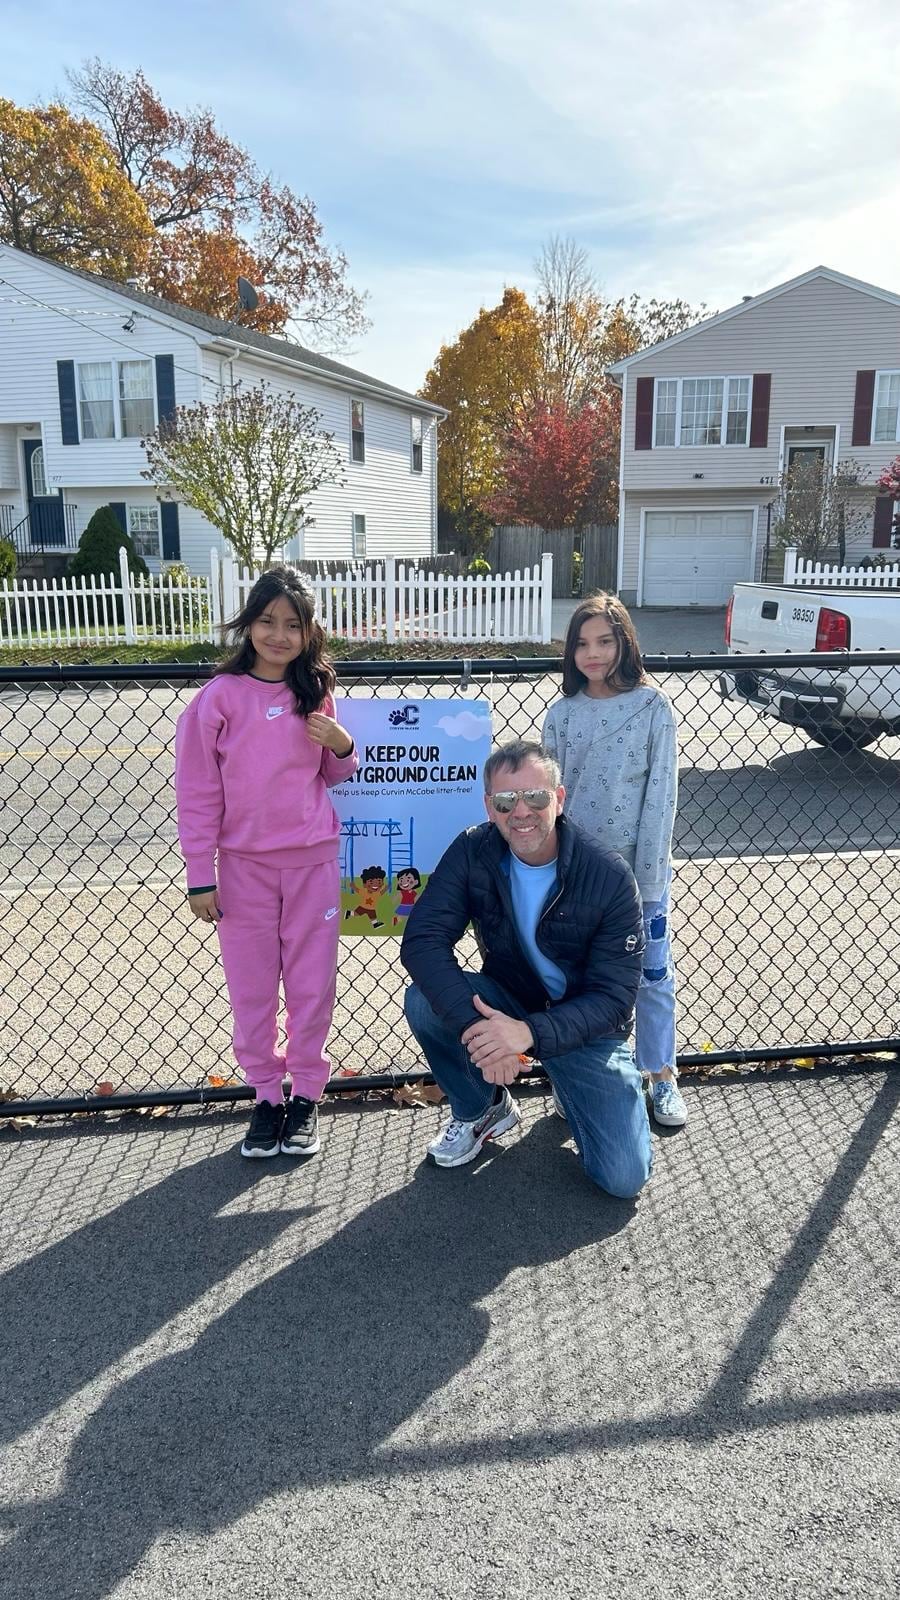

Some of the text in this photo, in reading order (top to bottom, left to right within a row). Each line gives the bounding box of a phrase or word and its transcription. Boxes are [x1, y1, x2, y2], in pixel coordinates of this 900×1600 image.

[792, 608, 815, 623] 38350
[365, 745, 440, 762] KEEP OUR
[344, 765, 477, 783] YGROUND CLEAN
[332, 788, 350, 797] Help
[361, 789, 380, 797] keep
[381, 788, 404, 796] Curvin
[405, 788, 435, 796] McCabe
[436, 786, 473, 795] litter-free!
